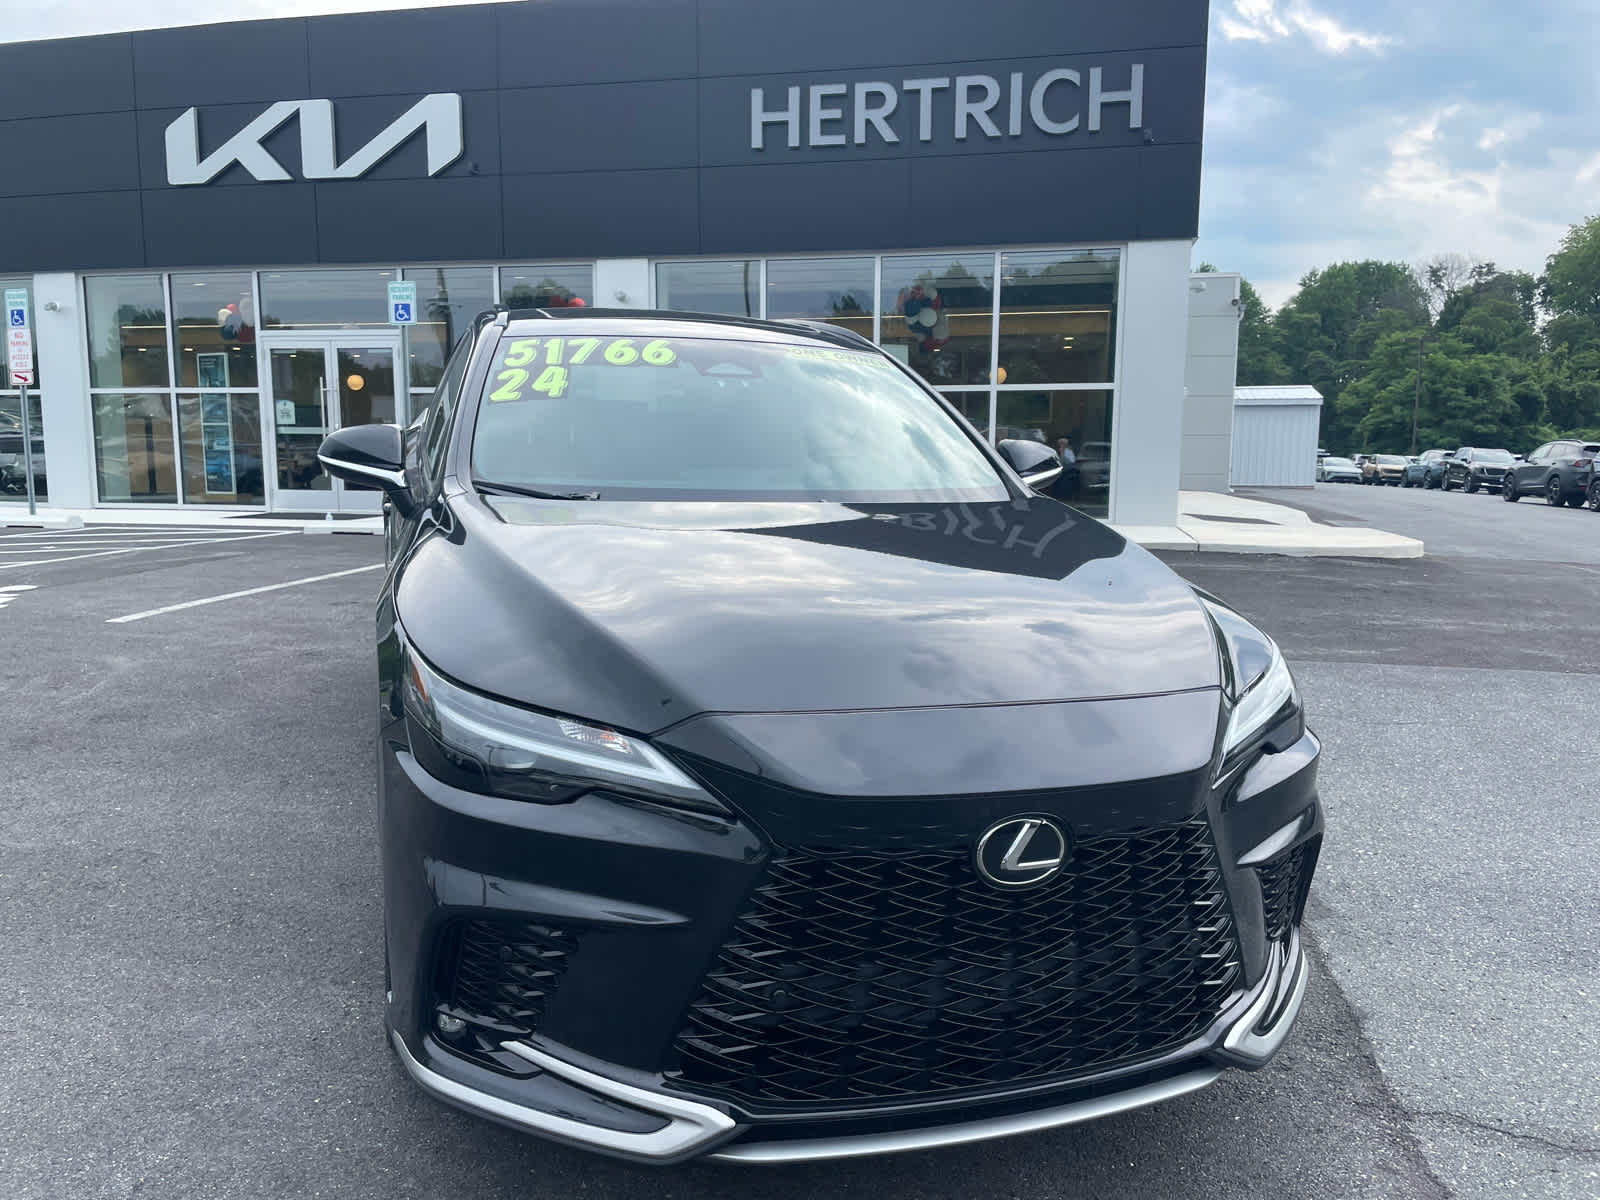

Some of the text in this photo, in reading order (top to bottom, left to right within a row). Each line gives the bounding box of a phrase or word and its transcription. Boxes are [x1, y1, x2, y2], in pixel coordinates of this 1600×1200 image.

[750, 63, 1145, 150] HERTRICH
[164, 92, 464, 186] KIA
[489, 365, 569, 402] 24
[503, 337, 678, 368] 51766
